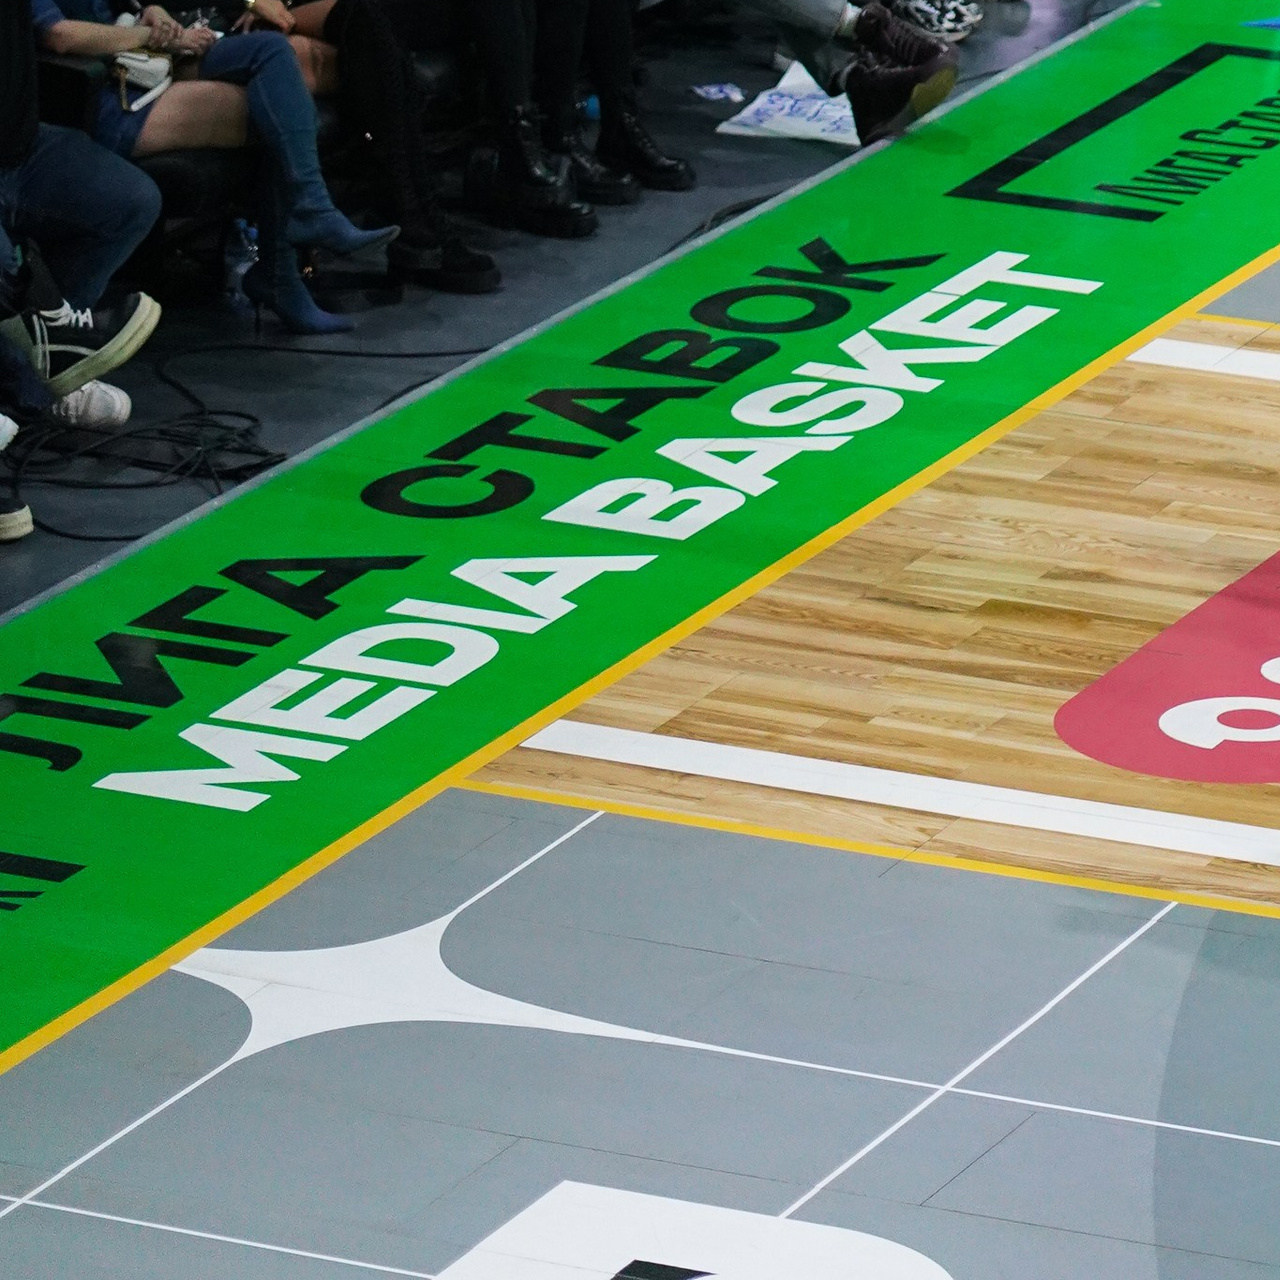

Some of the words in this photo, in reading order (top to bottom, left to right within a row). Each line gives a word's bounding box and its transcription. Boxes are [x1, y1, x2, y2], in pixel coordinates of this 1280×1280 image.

[0, 555, 427, 772] ЛИГА
[359, 237, 949, 519] СТАВОК
[92, 554, 658, 811] MEDIA
[541, 251, 1103, 541] BASKET
